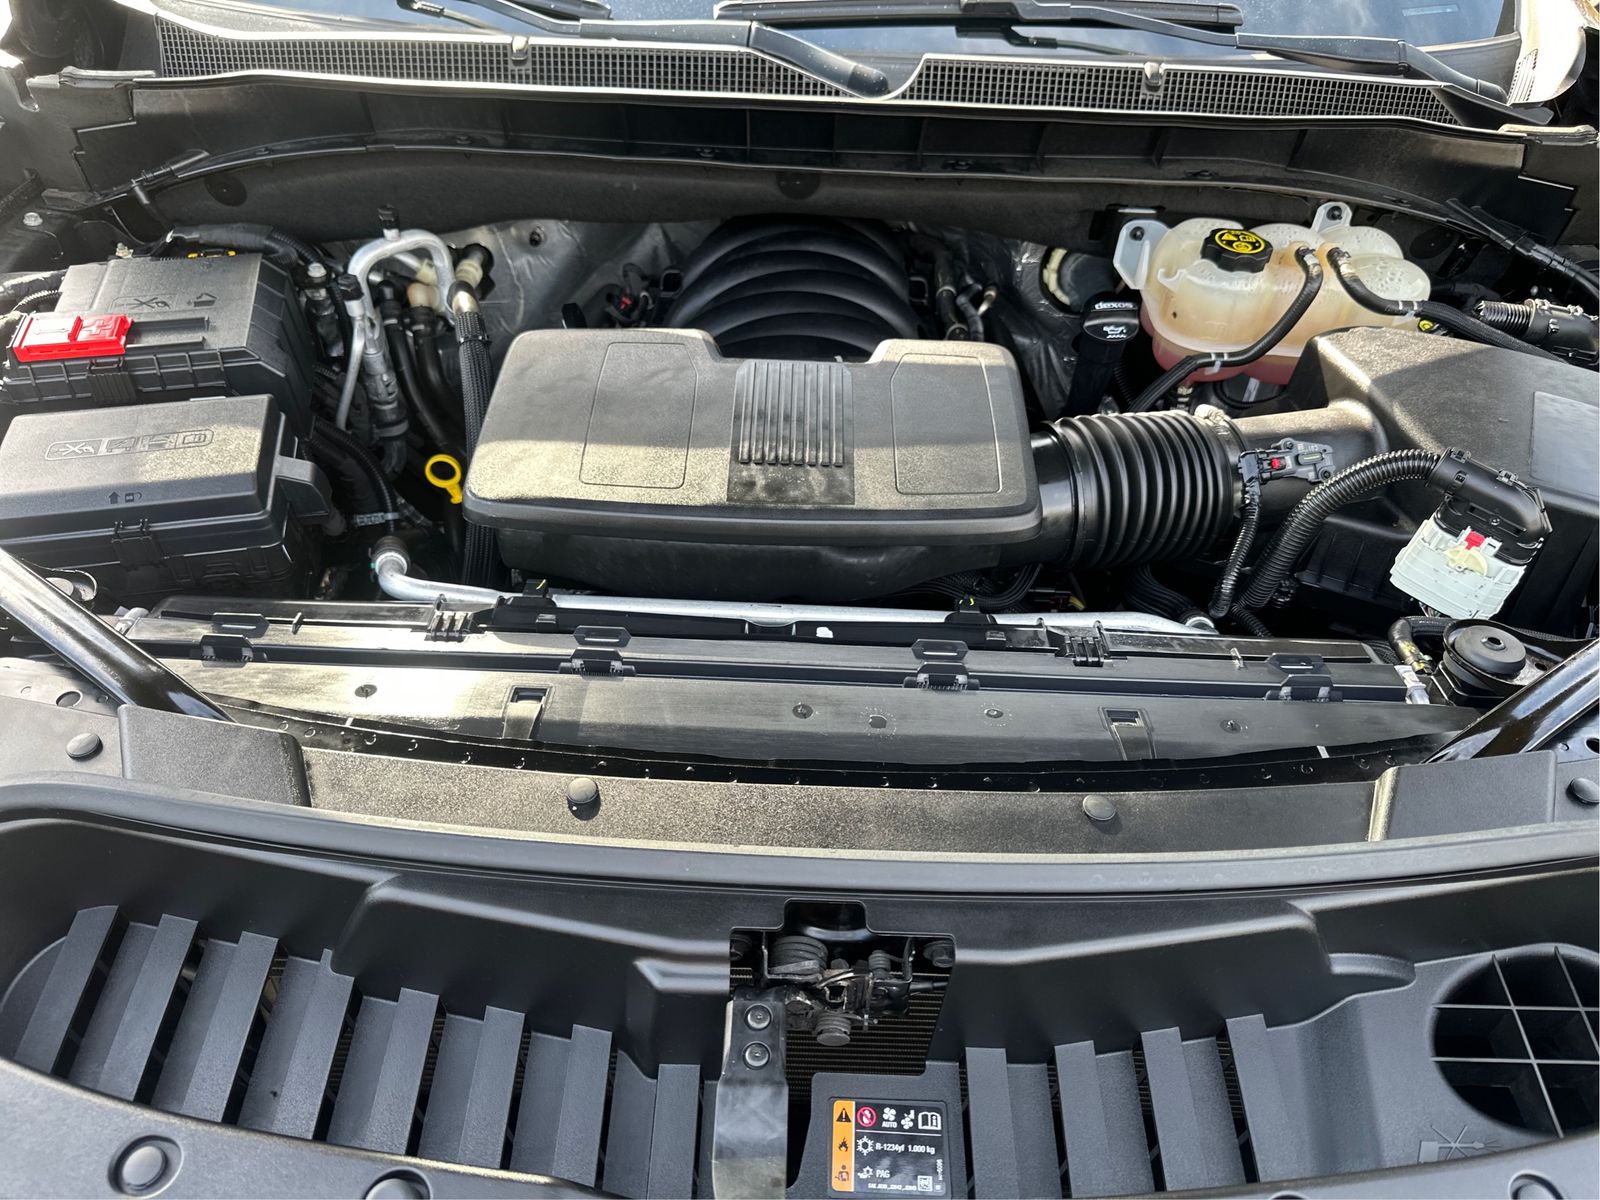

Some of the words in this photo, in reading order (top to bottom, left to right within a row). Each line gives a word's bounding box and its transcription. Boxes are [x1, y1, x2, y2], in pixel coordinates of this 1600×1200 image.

[1094, 301, 1133, 309] dexos
[875, 1143, 905, 1153] R-1234yf
[908, 1145, 926, 1153] 1.000
[926, 1146, 935, 1154] kg
[876, 1170, 890, 1178] PAG
